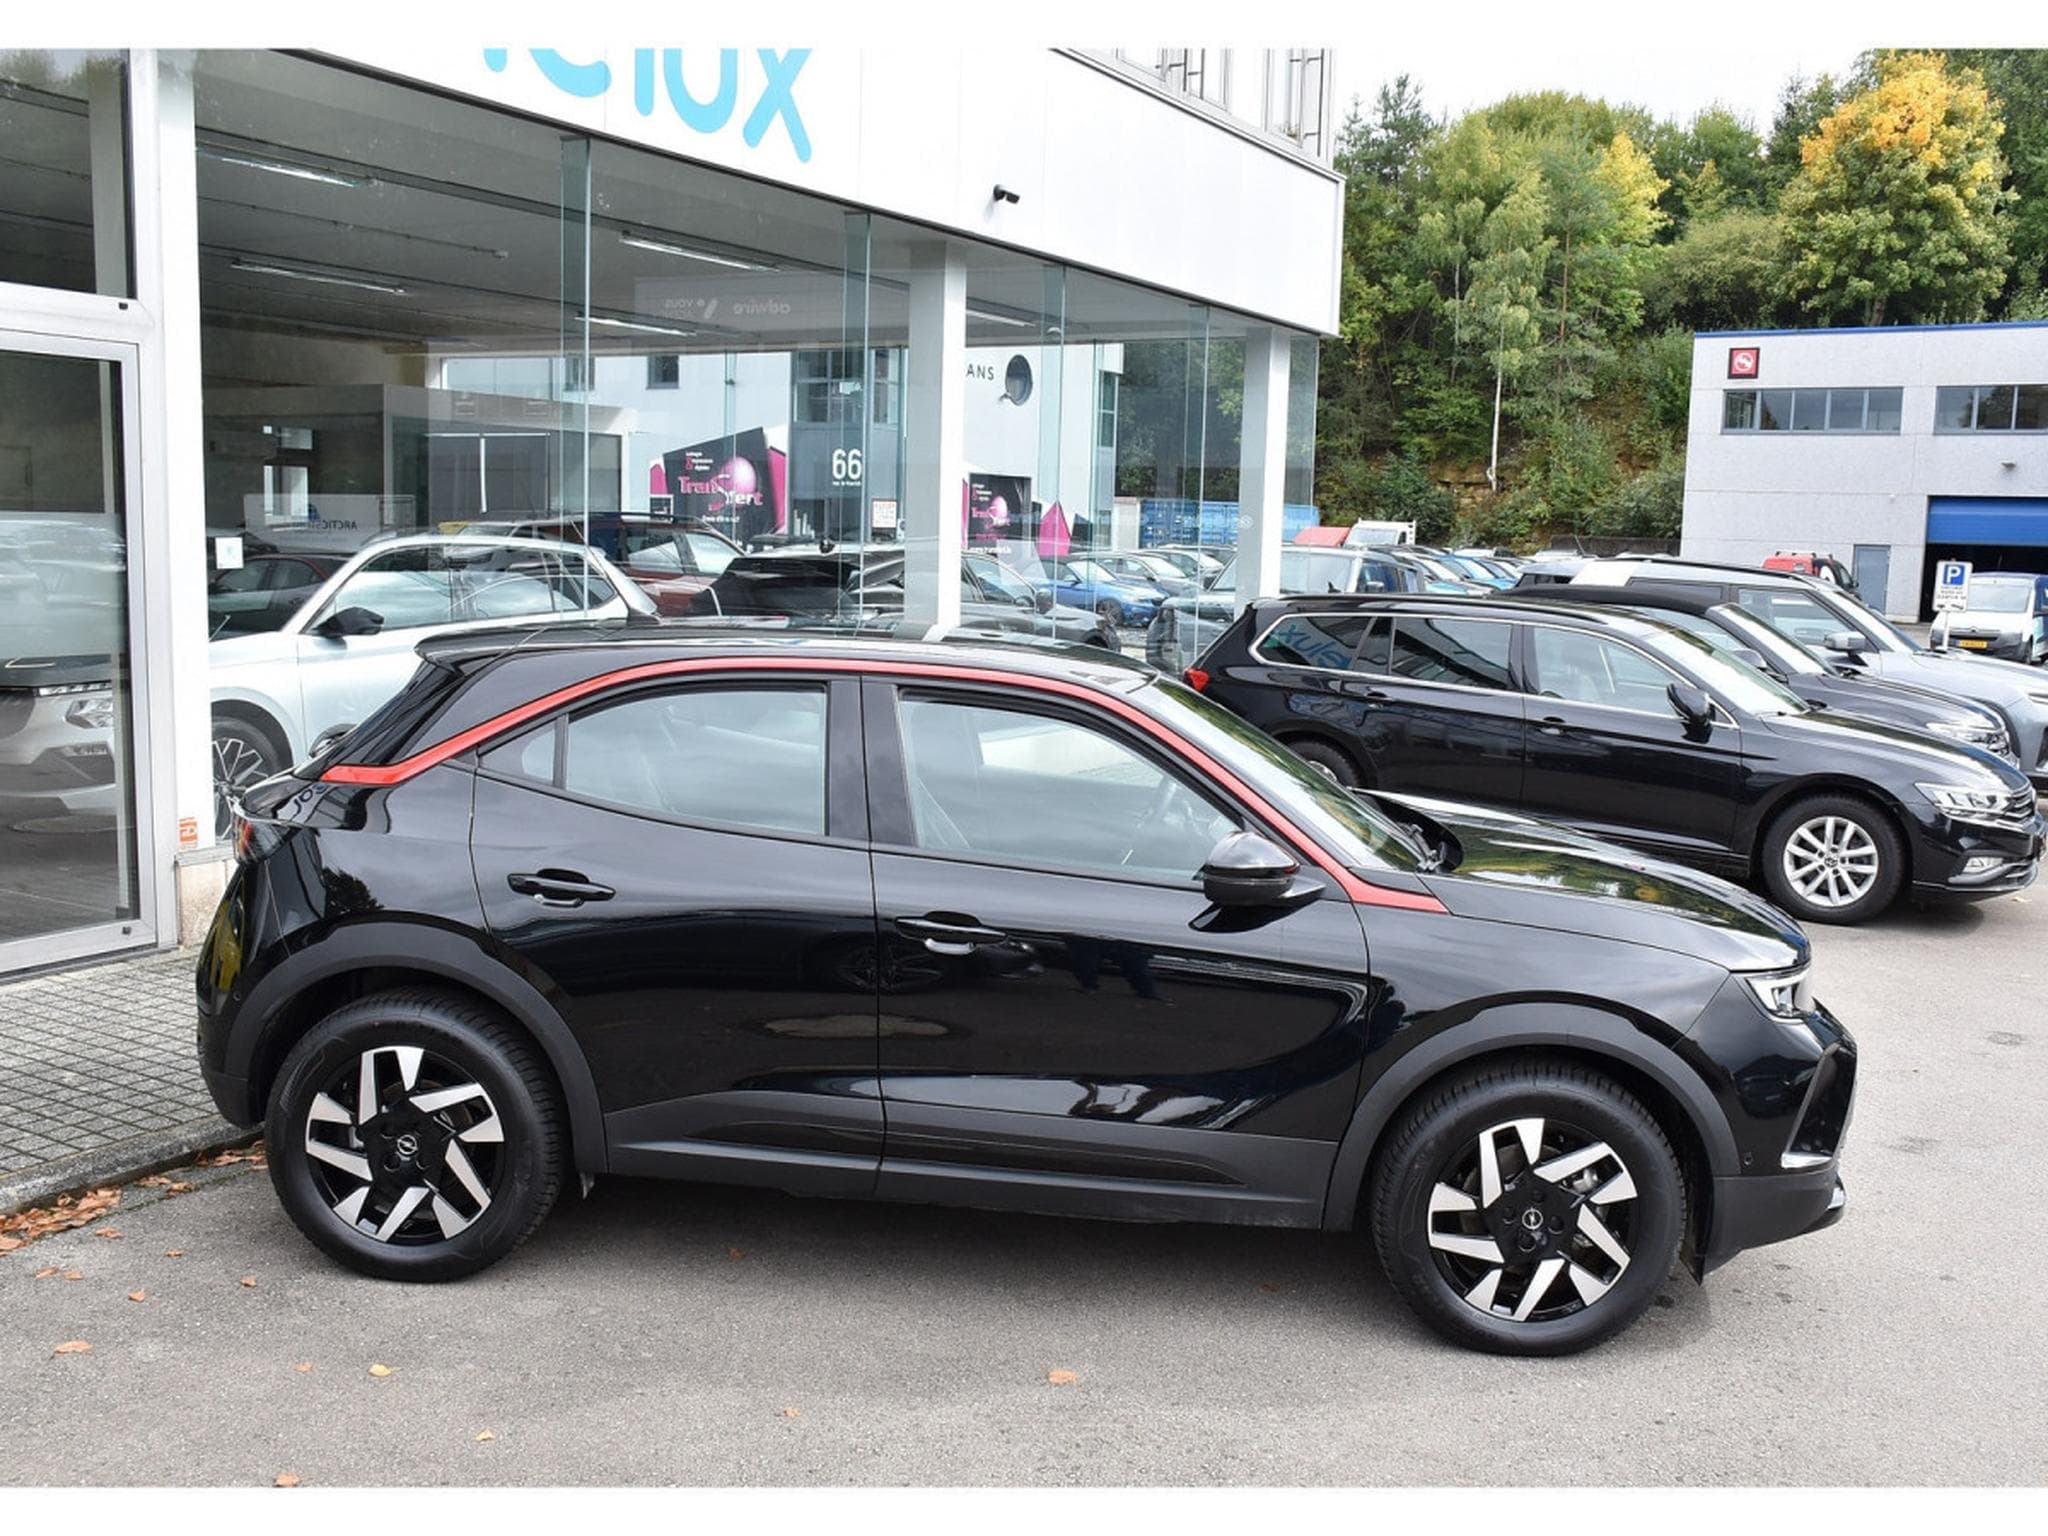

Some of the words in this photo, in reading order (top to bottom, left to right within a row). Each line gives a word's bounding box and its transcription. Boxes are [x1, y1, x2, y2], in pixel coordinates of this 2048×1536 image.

[966, 363, 995, 381] ANS
[832, 448, 862, 480] 66
[1946, 566, 1962, 584] P
